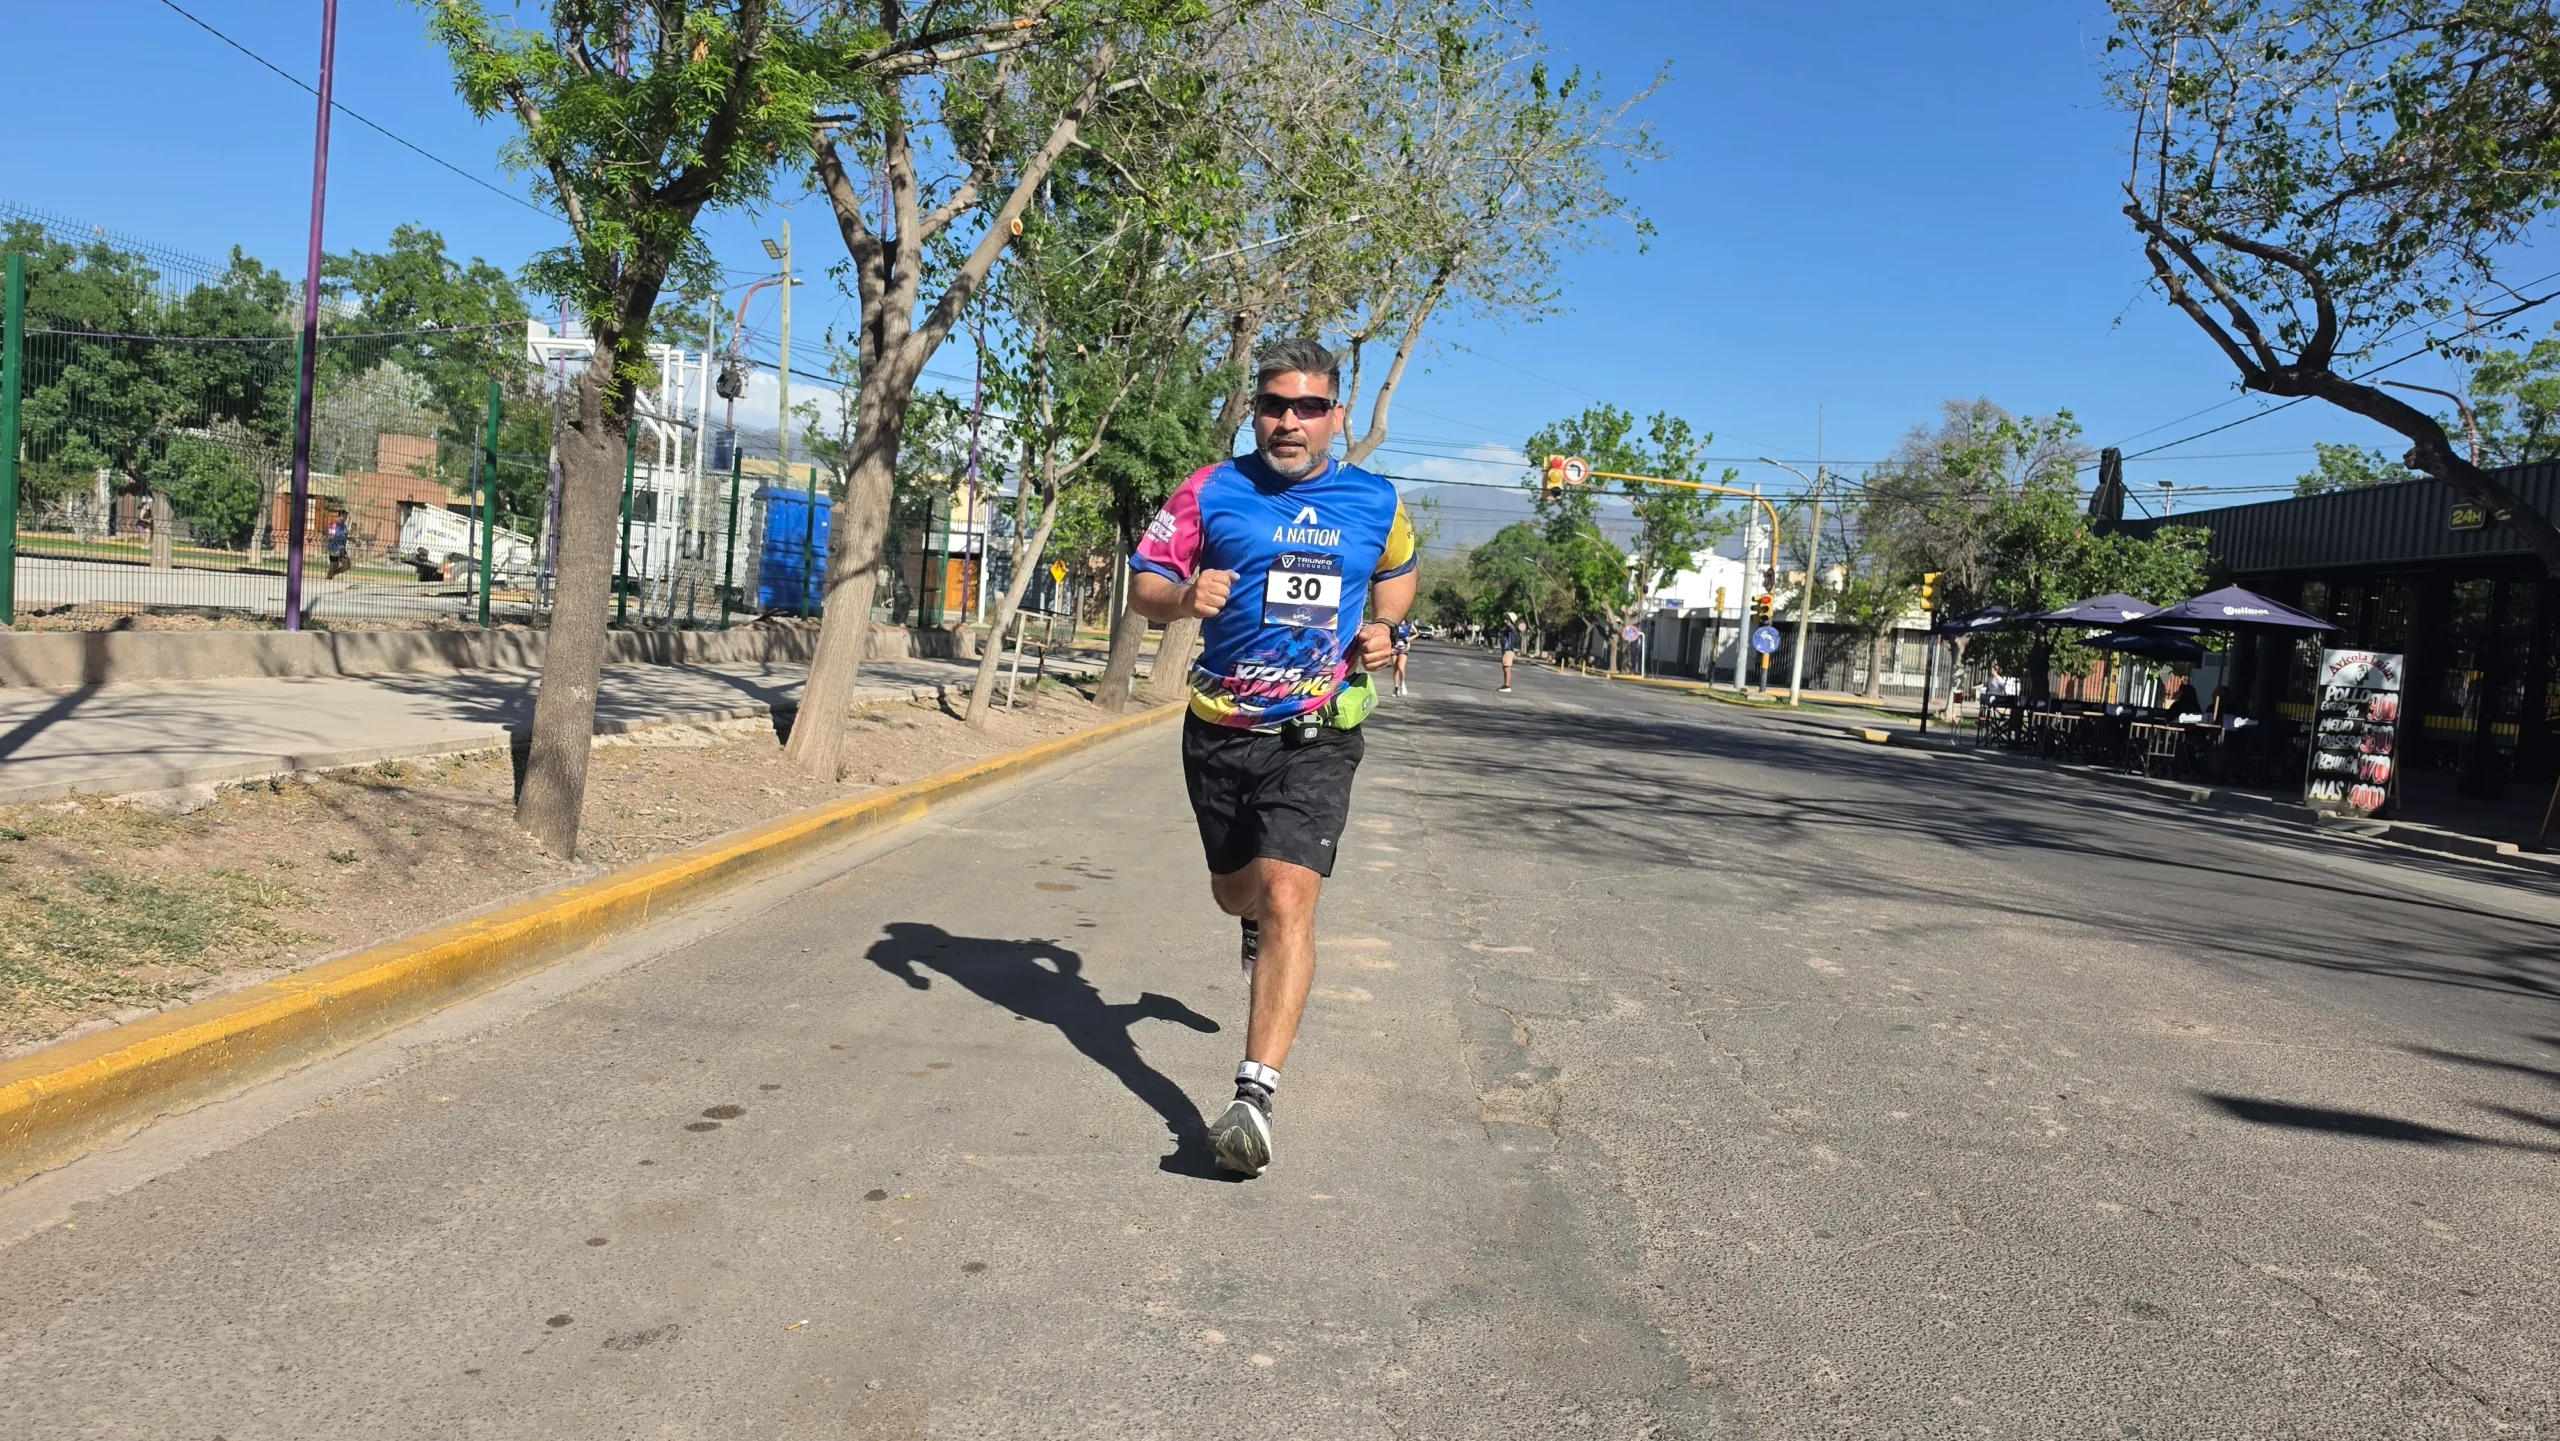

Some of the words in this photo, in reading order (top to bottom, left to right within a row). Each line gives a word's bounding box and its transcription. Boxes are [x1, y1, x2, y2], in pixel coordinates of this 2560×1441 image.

[2451, 509, 2481, 525] 24H
[1272, 526, 1283, 542] A
[1286, 527, 1341, 547] NATION
[1297, 557, 1332, 566] TRIUNFO
[1287, 576, 1321, 601] 30
[1235, 664, 1304, 682] KIDS
[1222, 674, 1332, 699] RUNNING
[2325, 685, 2372, 703] POLLO
[2320, 701, 2348, 711] ENTERO
[2318, 718, 2354, 732] MEDIO
[2317, 733, 2361, 749] TRASERO
[2311, 751, 2358, 774] PECHUGA
[2308, 778, 2344, 800] ALAS
[2347, 783, 2385, 809] 4000
